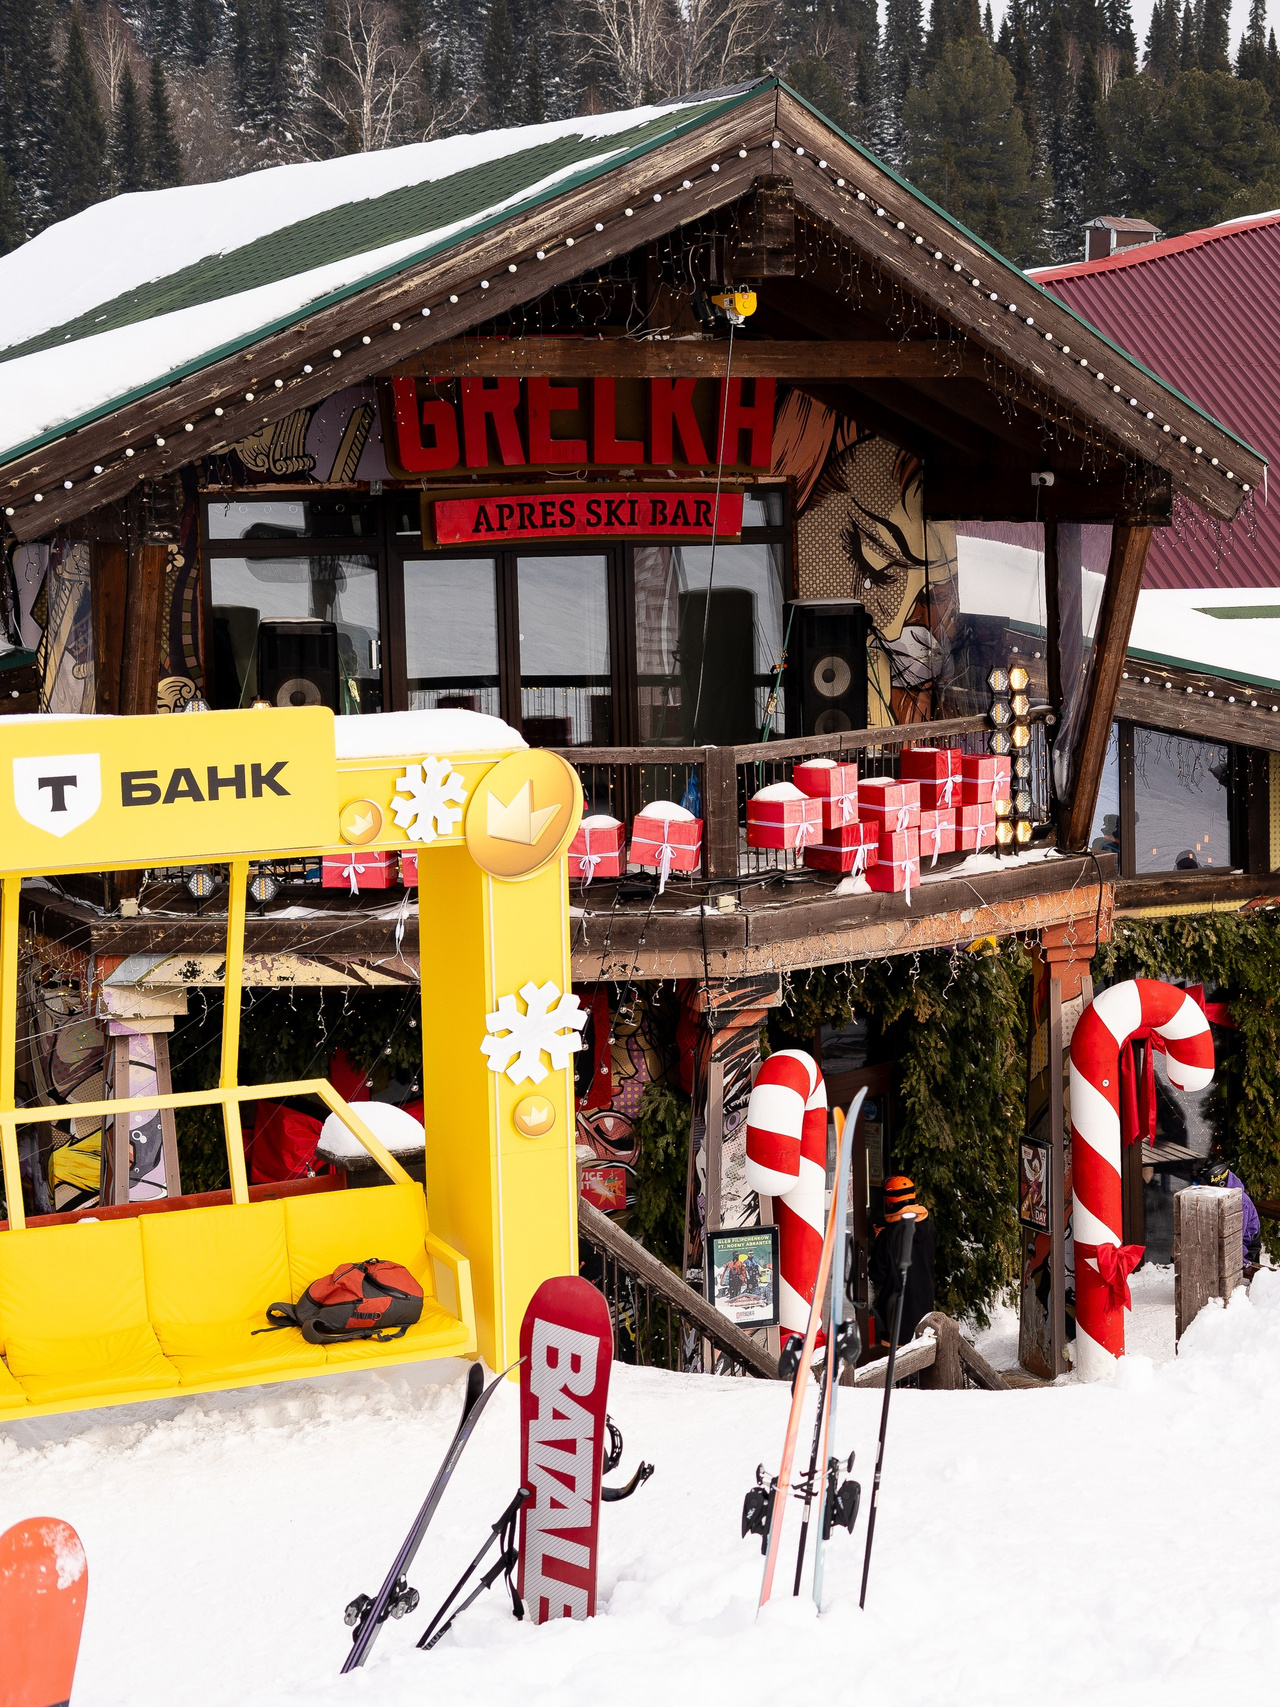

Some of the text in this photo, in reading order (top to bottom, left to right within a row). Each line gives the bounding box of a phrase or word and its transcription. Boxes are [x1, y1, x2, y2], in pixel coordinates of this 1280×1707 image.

[393, 377, 776, 472] GRELKA
[472, 499, 714, 533] APRES SKI BAR
[120, 760, 292, 808] БАНК
